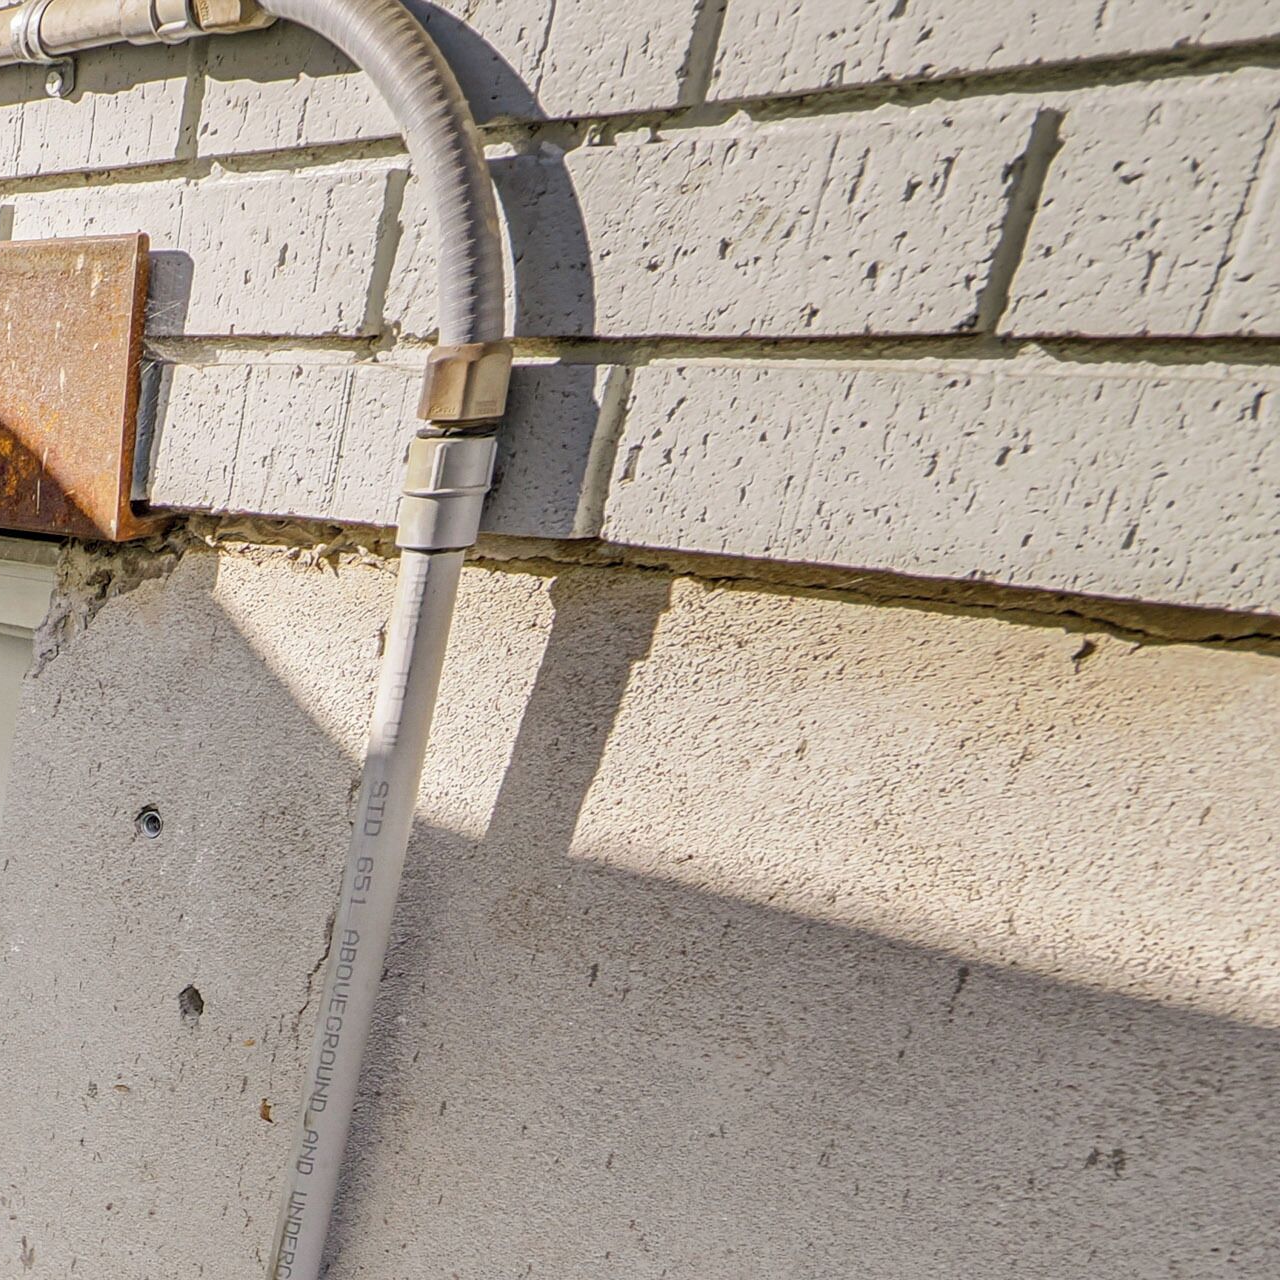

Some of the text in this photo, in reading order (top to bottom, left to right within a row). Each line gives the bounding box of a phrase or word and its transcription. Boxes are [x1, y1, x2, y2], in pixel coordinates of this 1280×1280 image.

[364, 781, 389, 836] STD
[351, 857, 374, 905] 651
[309, 929, 360, 1113] ABOVEGROUND
[296, 1129, 319, 1176] AND
